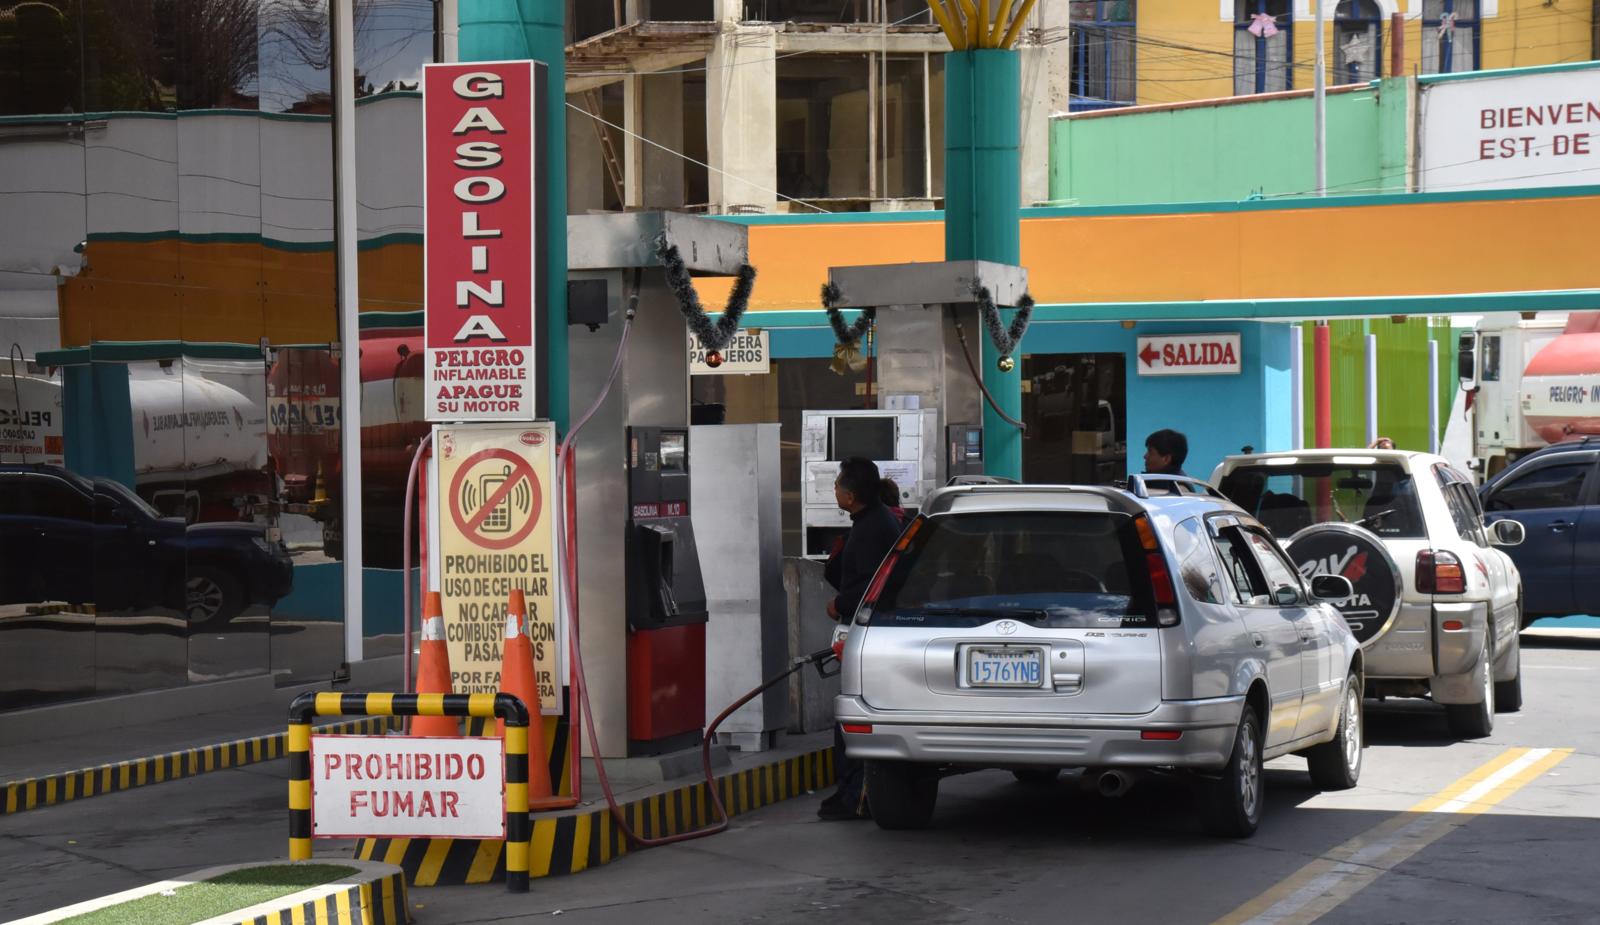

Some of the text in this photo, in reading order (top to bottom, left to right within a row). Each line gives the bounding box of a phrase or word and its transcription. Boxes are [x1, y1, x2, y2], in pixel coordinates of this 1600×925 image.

[1480, 133, 1590, 160] EST. DE
[452, 71, 507, 343] GASOLINA
[434, 349, 524, 367] PELIGRO
[690, 349, 763, 364] PAJEROS
[1163, 342, 1237, 367] SALIDA
[433, 368, 527, 381] INFLAMABLE
[437, 384, 523, 400] APAGUE
[437, 400, 520, 413] SU MOTOR
[445, 553, 549, 574] PROHIBIDO EL
[445, 578, 471, 597] USO
[474, 578, 490, 597] DE
[459, 601, 539, 621] NO CARR
[447, 621, 555, 642] COMBUST CON
[451, 671, 482, 684] POR
[974, 661, 1040, 682] 1576YNB
[324, 752, 485, 781] PROHIBIDO
[350, 790, 459, 818] FUMAR
